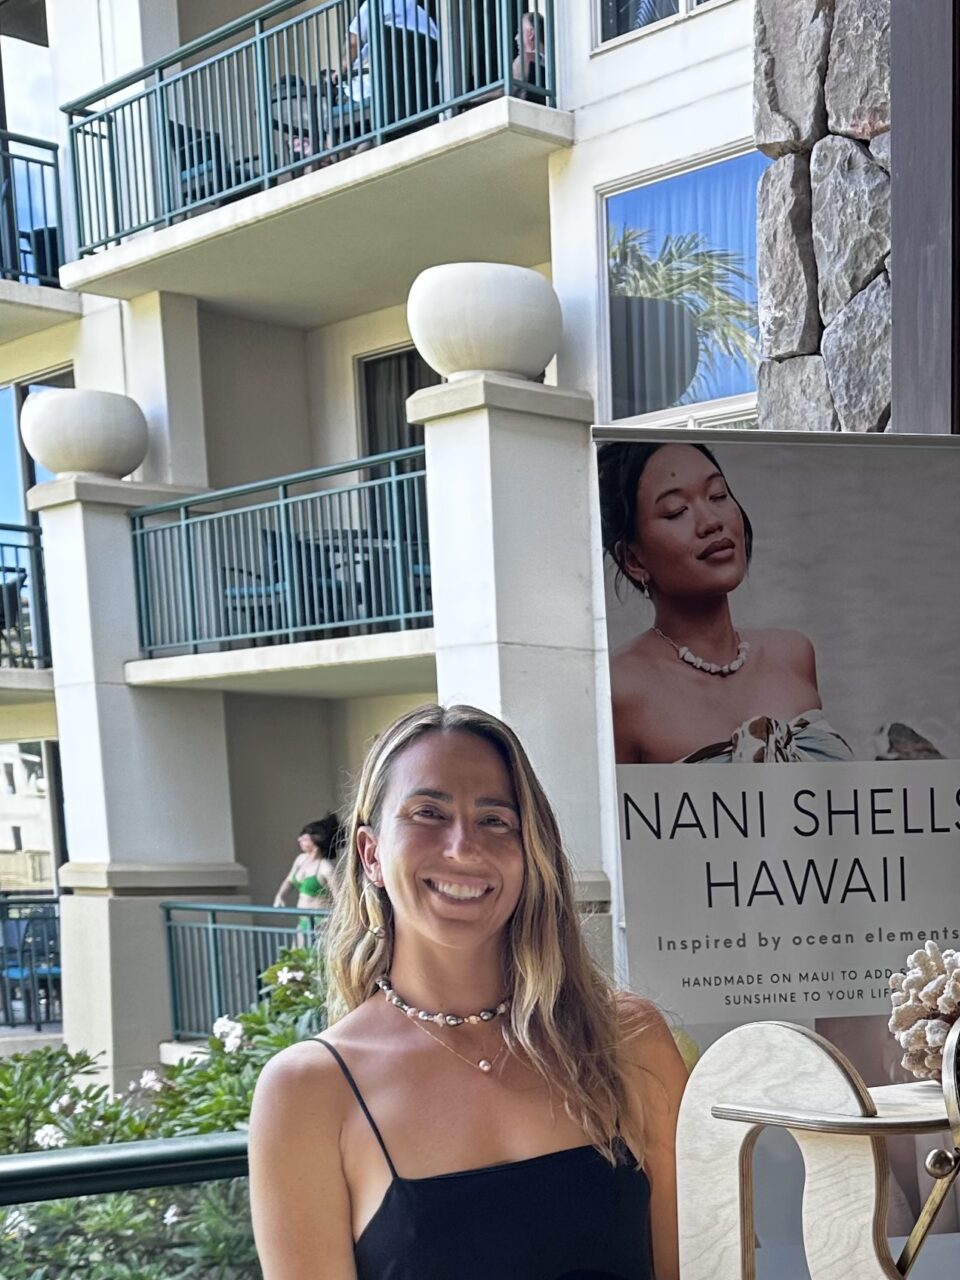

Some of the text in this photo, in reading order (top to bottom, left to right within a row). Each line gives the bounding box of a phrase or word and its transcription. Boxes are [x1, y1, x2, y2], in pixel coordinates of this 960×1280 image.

[623, 790, 767, 840] NANI
[705, 855, 906, 908] HAWAII
[658, 926, 960, 953] Inspired by ocean elements
[681, 974, 764, 988] HANDMADE
[770, 973, 792, 984] ON
[799, 971, 835, 983] MAUI
[841, 970, 858, 981] TO
[864, 968, 893, 980] ADD
[724, 992, 797, 1005] SUNSHINE
[803, 991, 821, 1002] TO
[827, 989, 864, 1001] YOUR
